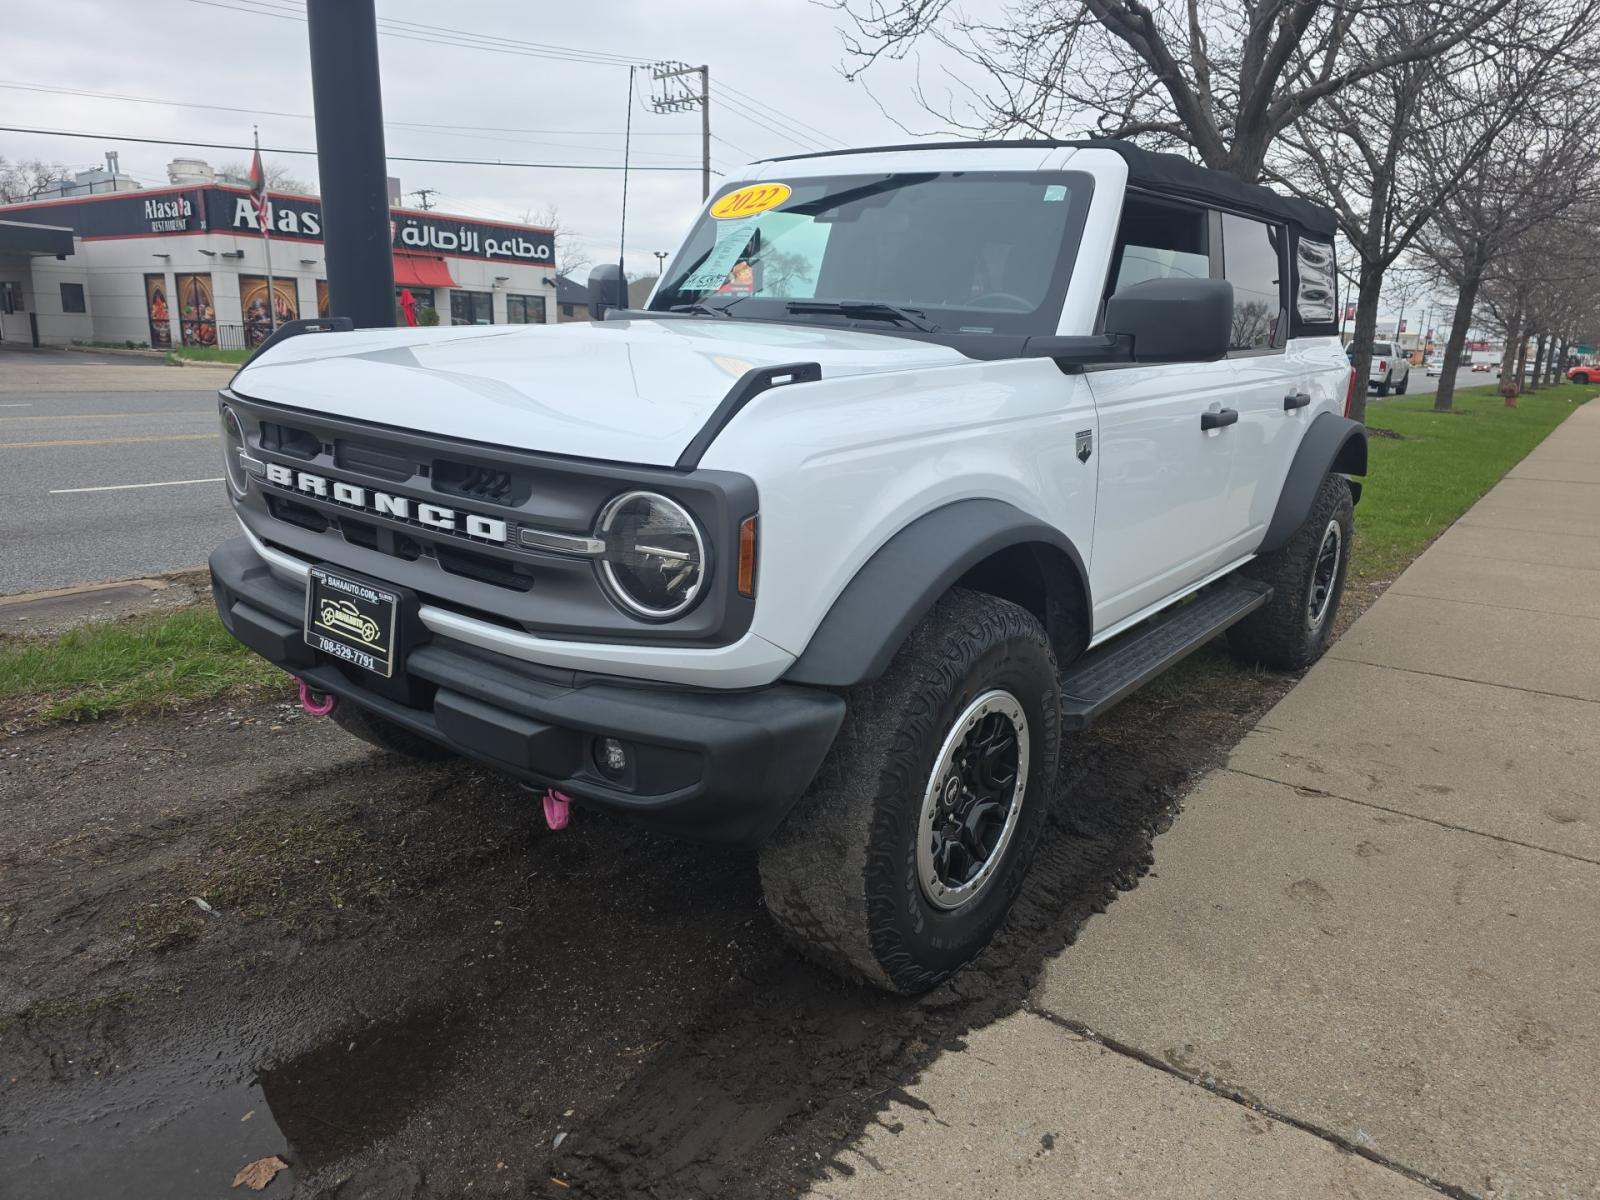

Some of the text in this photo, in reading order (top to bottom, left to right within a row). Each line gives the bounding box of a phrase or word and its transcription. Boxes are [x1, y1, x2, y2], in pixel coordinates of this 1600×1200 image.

[145, 198, 192, 219] Alasala
[719, 187, 780, 214] 2022
[402, 219, 550, 260] مطاعم الأصالة
[266, 463, 507, 543] BRONCO
[319, 637, 375, 669] 708-529-7791
